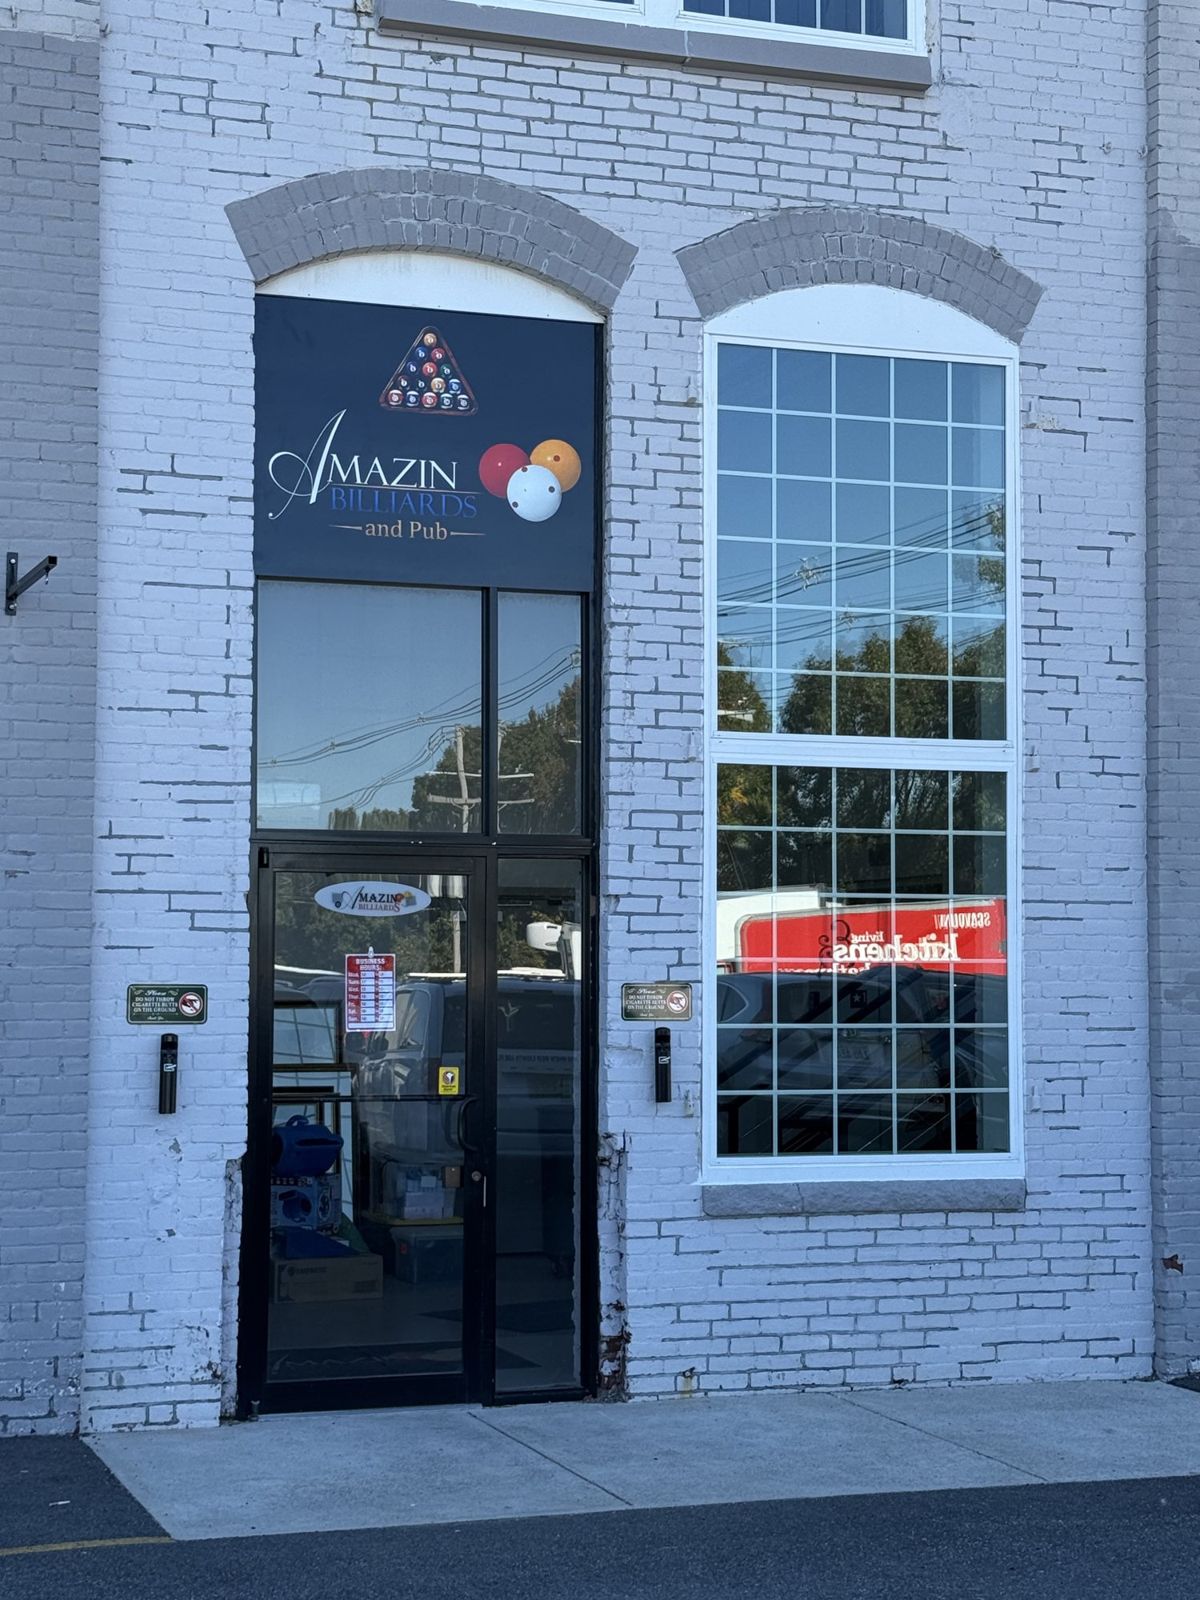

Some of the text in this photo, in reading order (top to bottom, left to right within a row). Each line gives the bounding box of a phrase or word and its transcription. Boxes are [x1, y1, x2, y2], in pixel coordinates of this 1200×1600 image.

[329, 487, 478, 519] BILLIARDS
[365, 520, 448, 541] and Pub
[358, 903, 401, 913] BILLIARDS
